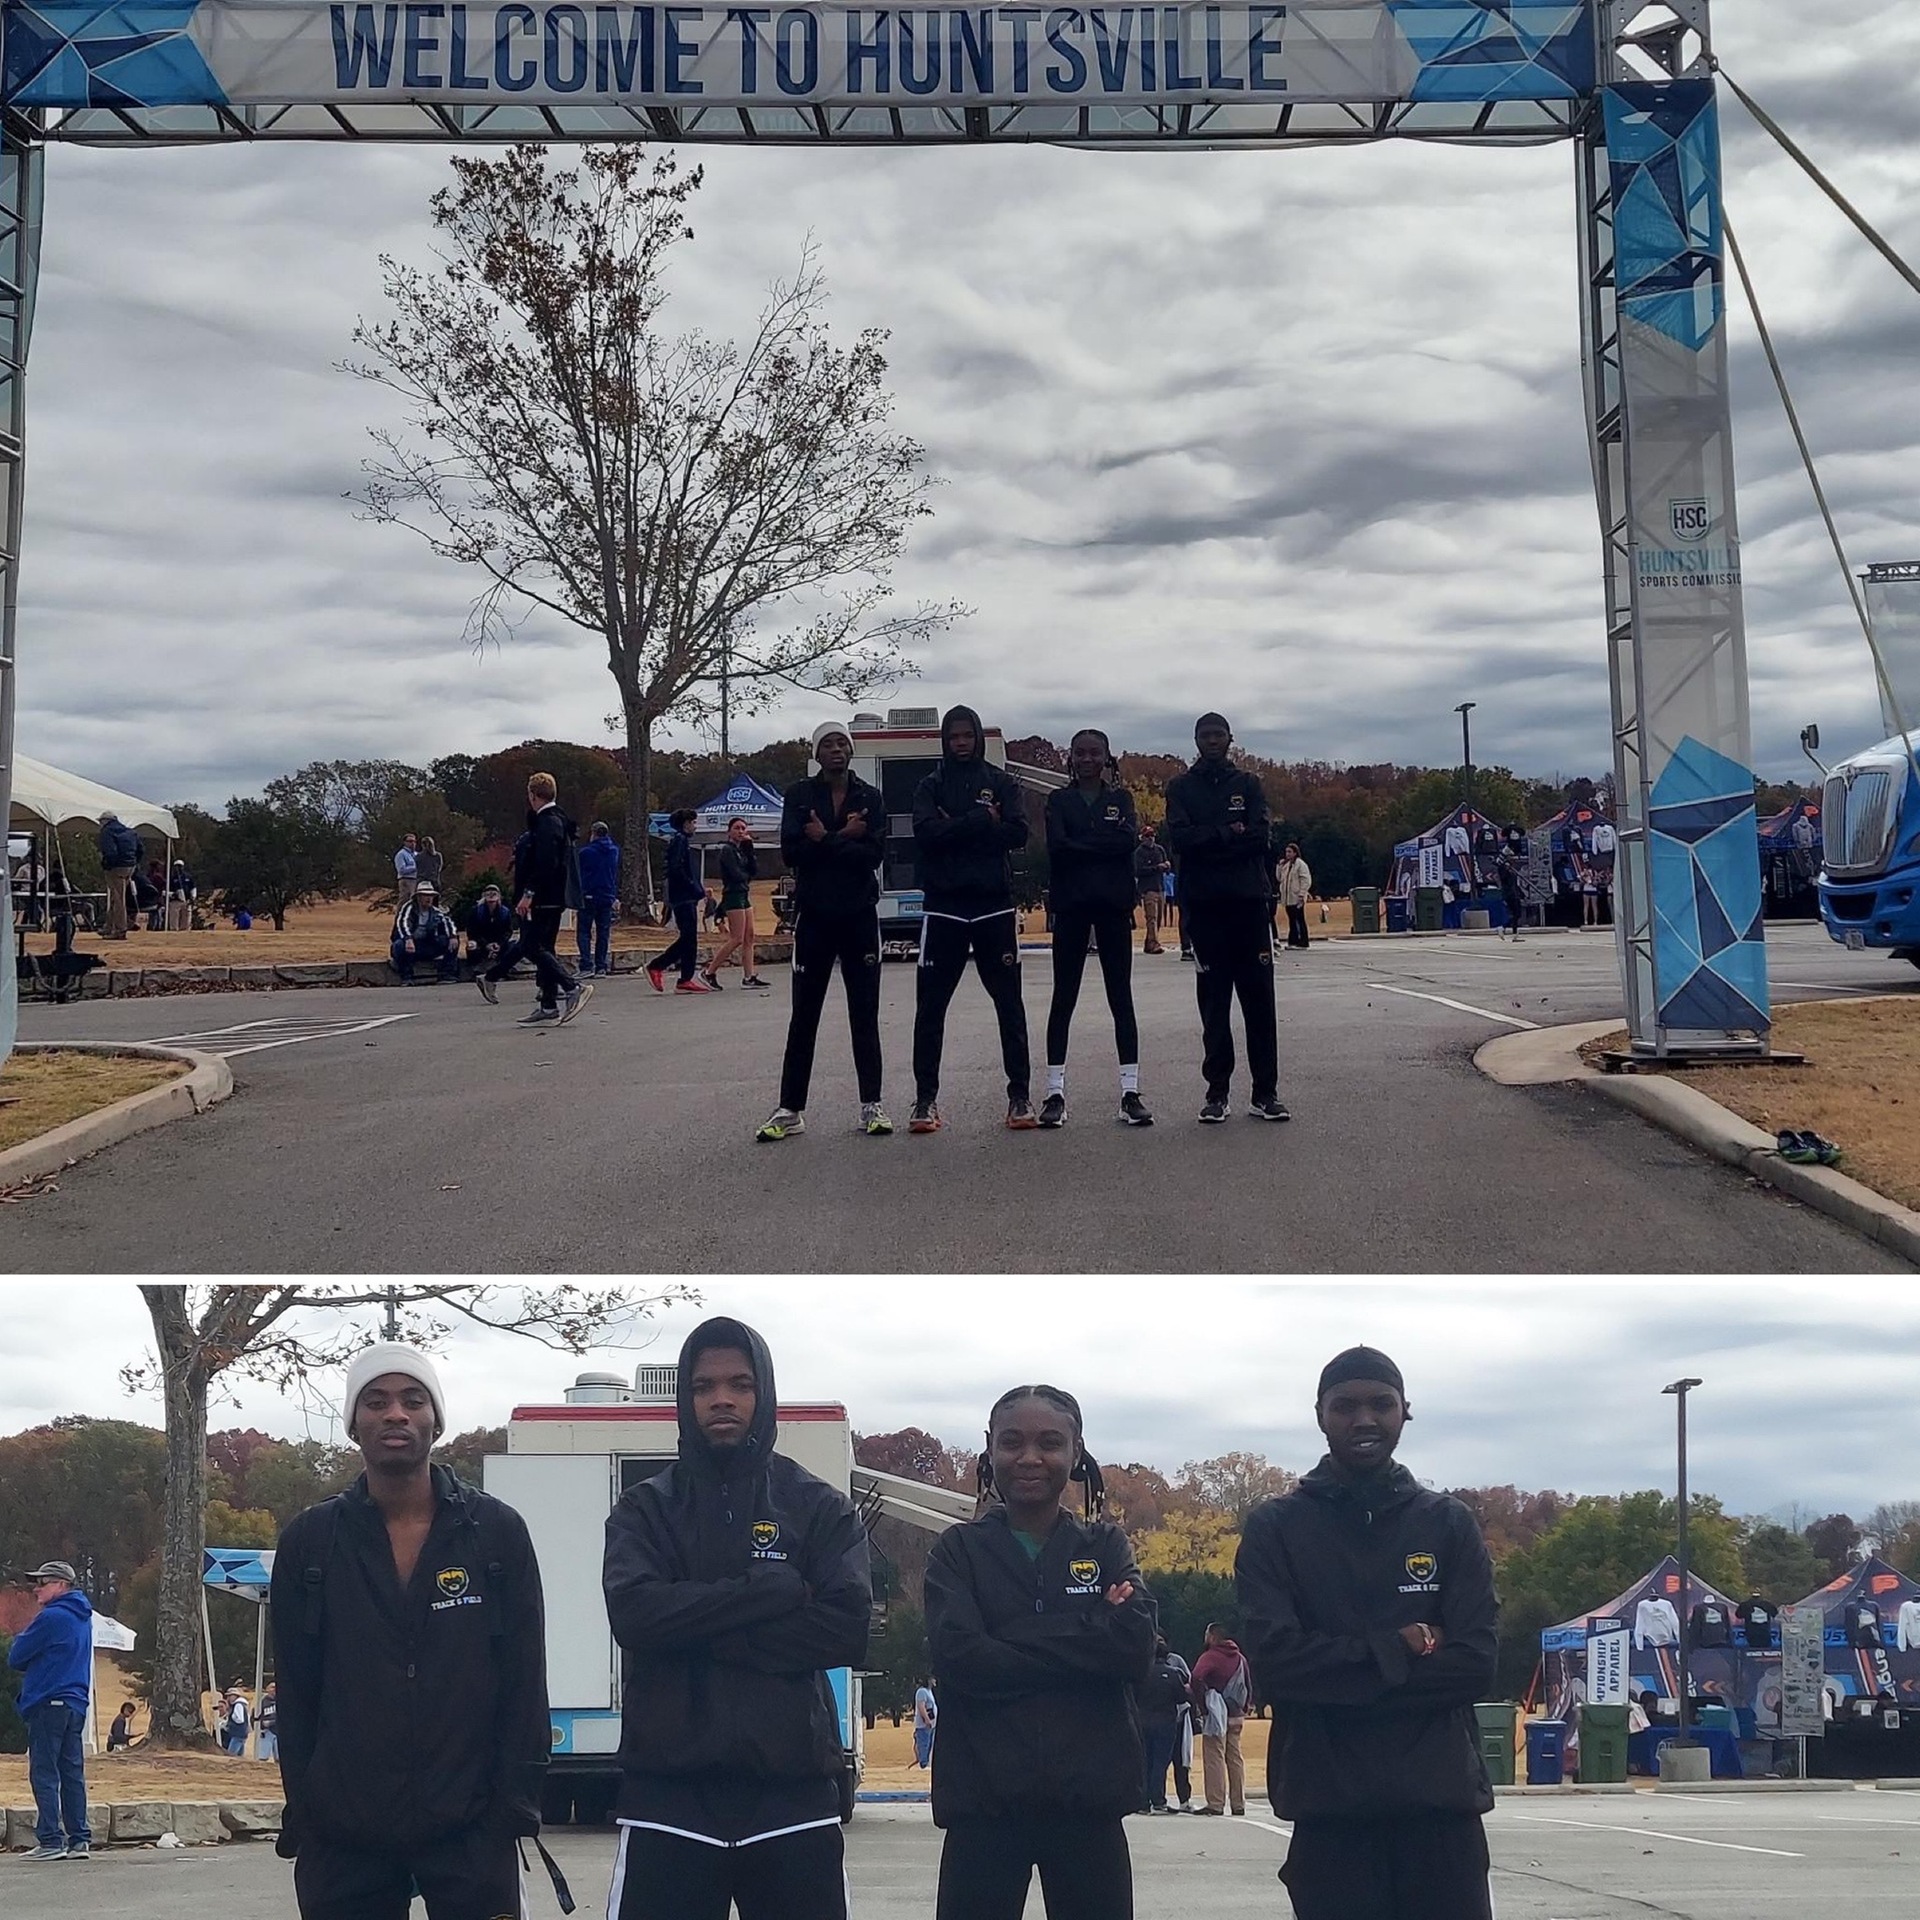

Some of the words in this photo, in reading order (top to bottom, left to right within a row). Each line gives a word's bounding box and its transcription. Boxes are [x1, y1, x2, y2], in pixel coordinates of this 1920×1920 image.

[330, 3, 704, 93] WELCOME
[727, 6, 818, 95] TO
[846, 5, 1288, 95] HUNTSVILLE
[1673, 507, 1707, 530] HSC
[1640, 575, 1679, 588] SPORTS
[705, 804, 767, 812] HUNTSVILLE
[431, 1599, 456, 1610] TRACK
[1609, 1639, 1620, 1693] APPAREL
